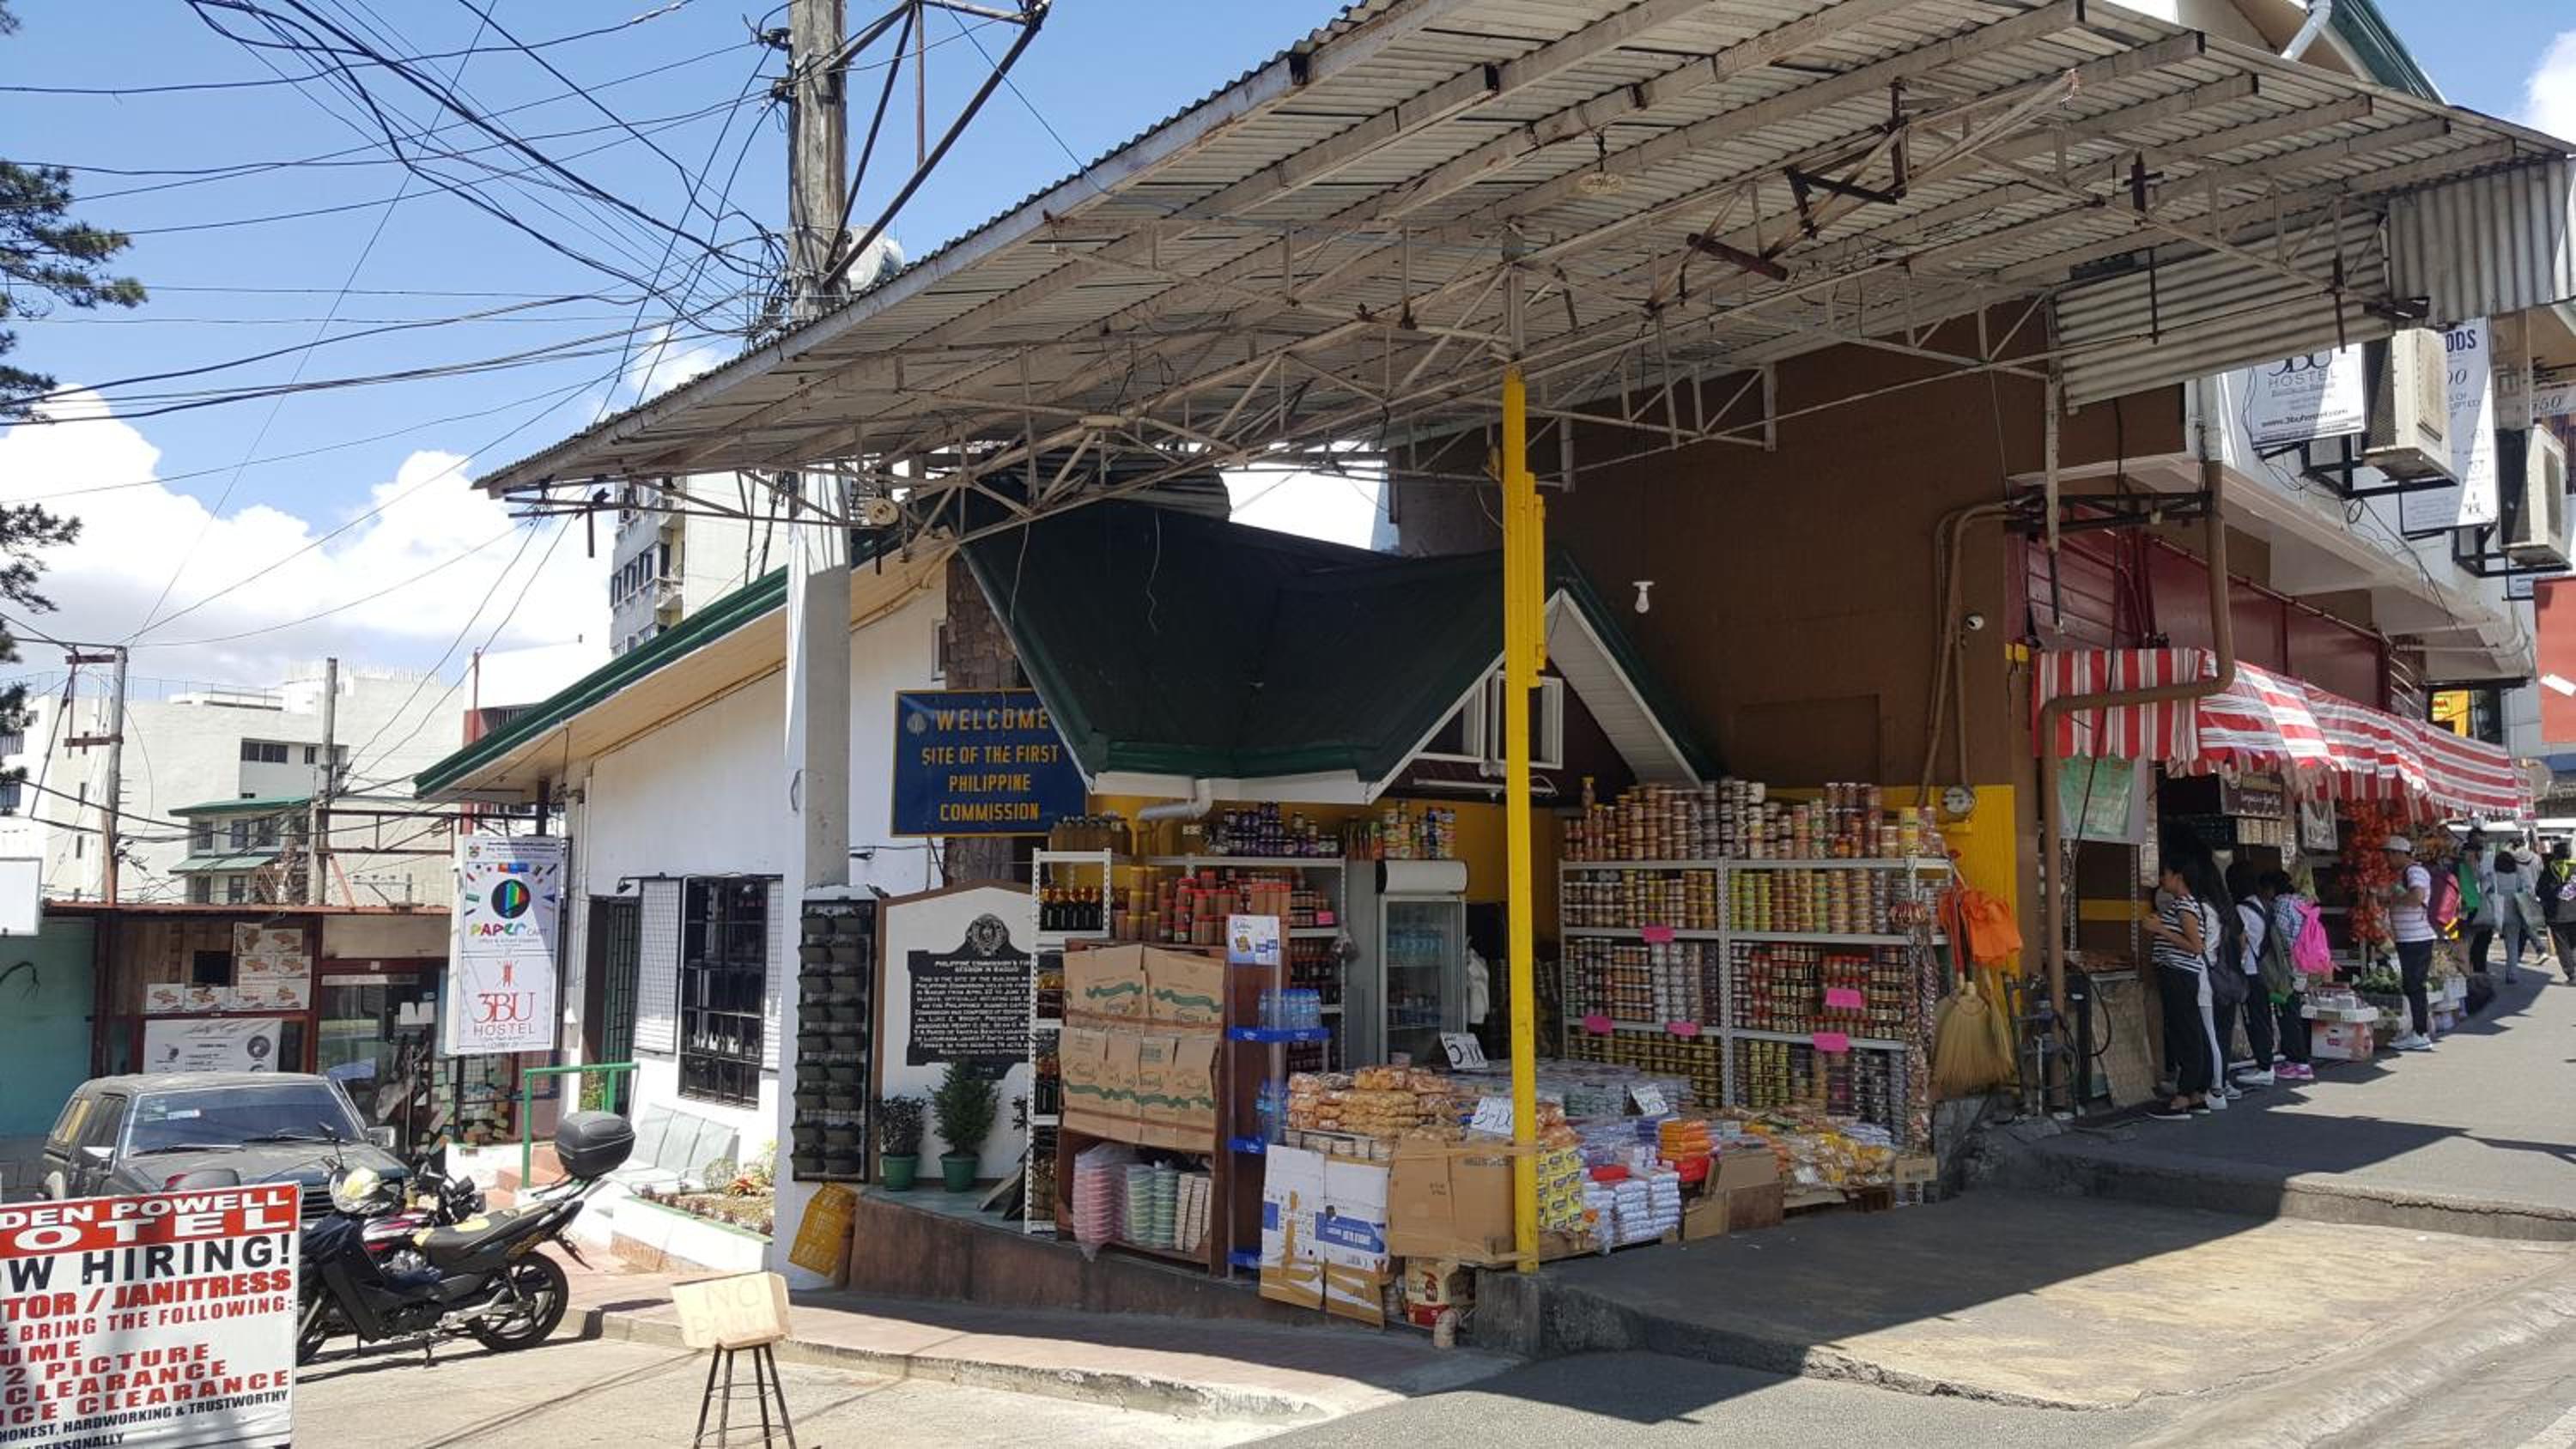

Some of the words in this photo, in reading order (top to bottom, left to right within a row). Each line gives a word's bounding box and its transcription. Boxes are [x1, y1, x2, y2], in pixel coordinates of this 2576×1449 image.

[935, 706, 1049, 731] WELCOME
[921, 747, 954, 765] SITE
[959, 746, 978, 764] OF
[984, 745, 1011, 763] THE
[1016, 744, 1059, 763] FIRST
[949, 773, 1030, 792] PHILIPPINE
[939, 803, 1039, 822] COMMISSION
[474, 992, 536, 1023] 3BU
[473, 1023, 536, 1036] HOSTEL
[0, 1205, 94, 1230] DEN
[112, 1191, 289, 1218] POWELL
[14, 1208, 289, 1250] OTEL
[82, 1234, 291, 1285] HIRING!
[85, 1288, 105, 1314] /
[112, 1269, 292, 1310] JANITRESS
[20, 1318, 96, 1343] BRING
[107, 1311, 149, 1331] THE
[159, 1295, 293, 1326] FOLLOWING:
[5, 1367, 27, 1386] 2
[46, 1343, 210, 1381] PICTURE
[5, 1359, 227, 1405] CLEARANCE
[76, 1369, 289, 1416] CLEARANCE
[0, 1422, 59, 1442] HONEST,
[64, 1406, 172, 1434] HARDWORKING
[175, 1404, 185, 1416] &
[188, 1389, 289, 1415] TRUSTWORTHY
[35, 1432, 125, 1449] RSONALLY
